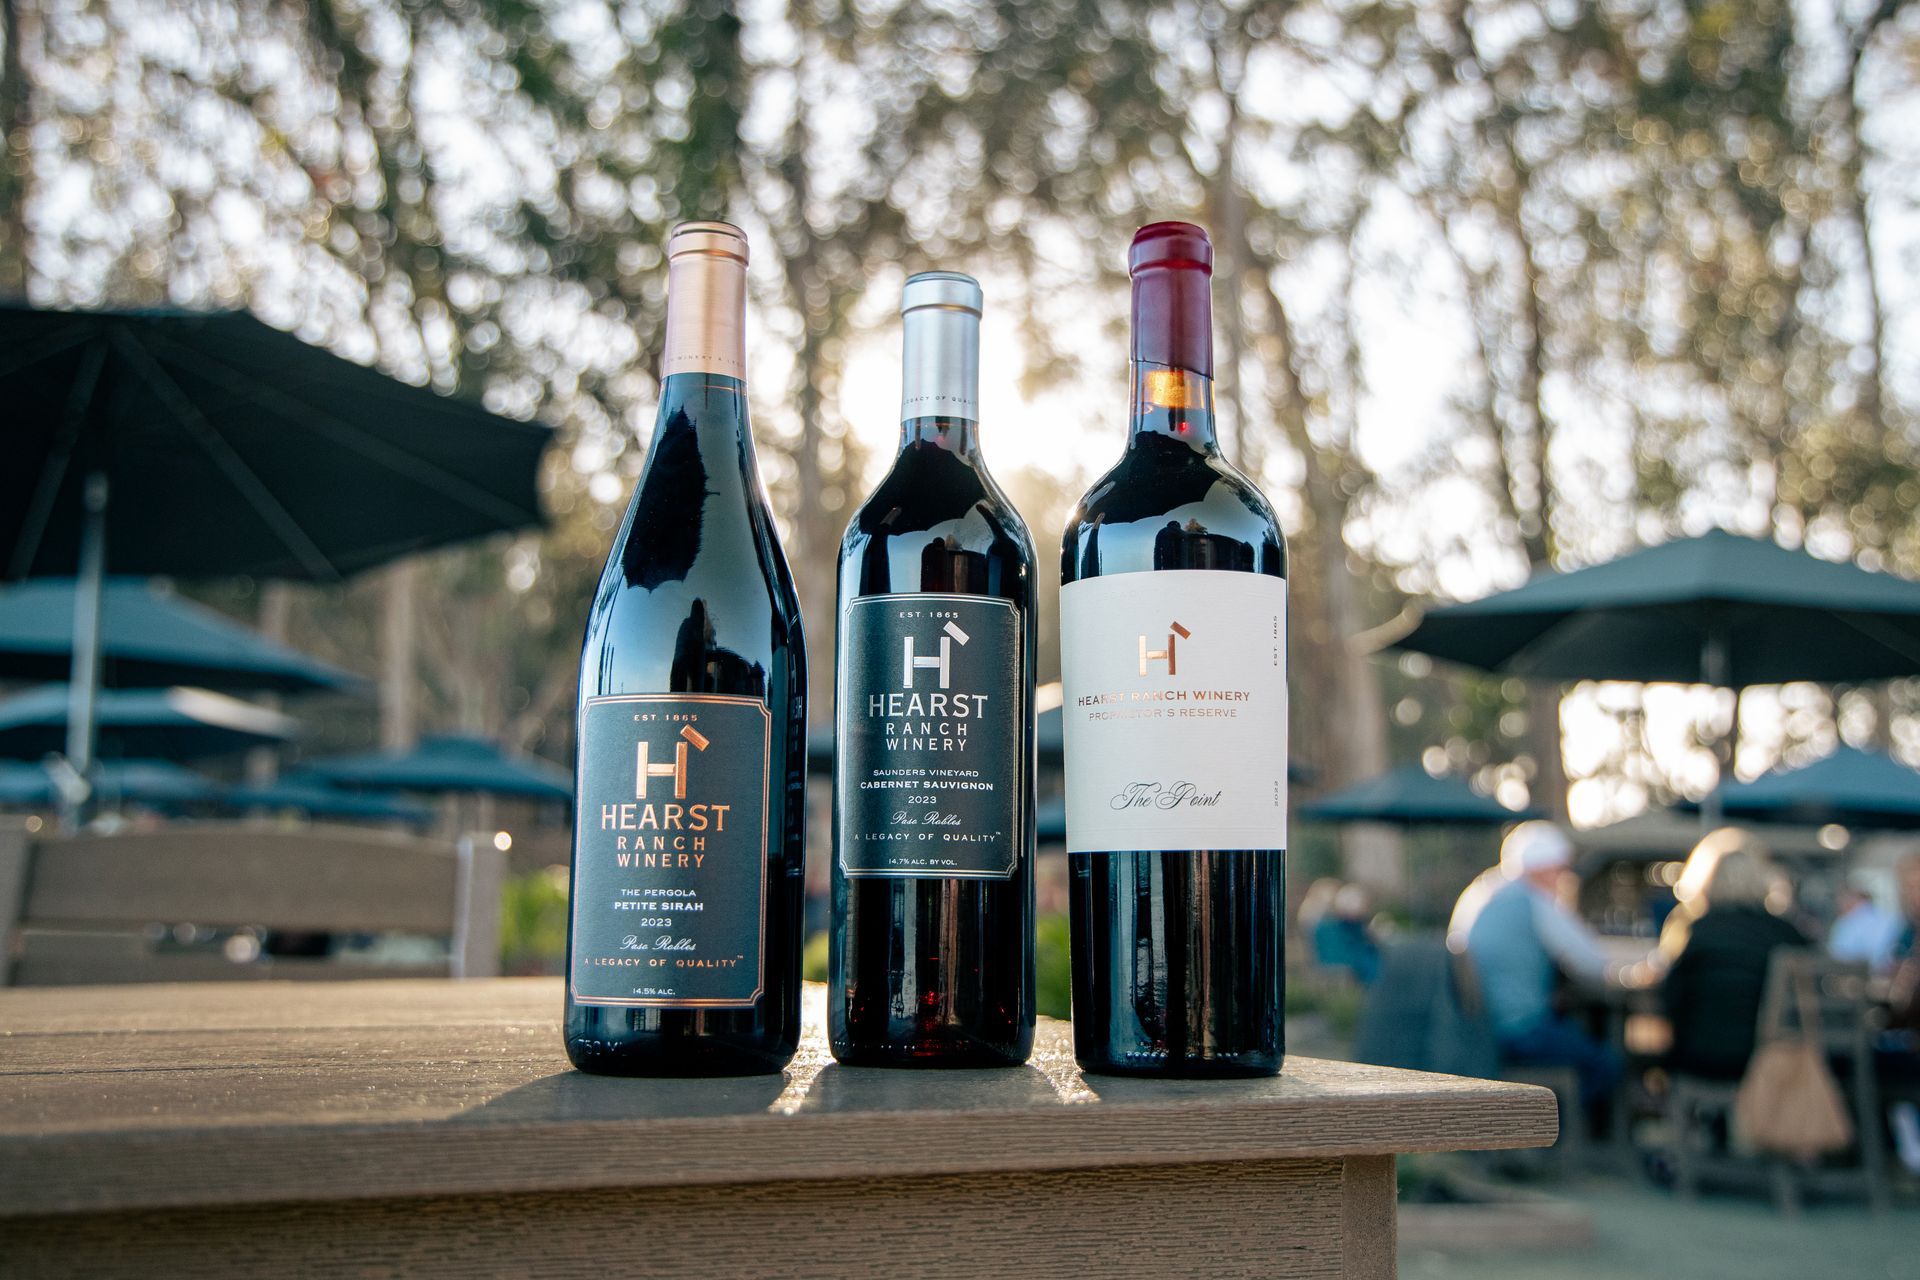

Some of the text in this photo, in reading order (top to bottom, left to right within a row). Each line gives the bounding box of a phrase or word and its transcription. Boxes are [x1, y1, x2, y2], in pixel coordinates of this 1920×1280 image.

[929, 611, 959, 619] 1865
[1078, 690, 1251, 707] HEARST RANCH WINERY
[868, 692, 989, 719] HEARST
[665, 714, 699, 722] 1865
[1180, 708, 1238, 719] RESERVE
[886, 722, 968, 736] RANCH
[886, 738, 968, 751] WINERY
[873, 769, 979, 778] SAUNDERS VINEYARD
[860, 781, 994, 791] CABERNET SAUVIGNON
[908, 795, 937, 804] 2023
[1110, 780, 1222, 810] The Point
[601, 803, 731, 832] HEARST
[890, 810, 962, 826] Paso Robles
[854, 833, 859, 841] A
[865, 833, 910, 841] LEGACY
[918, 833, 935, 841] OF
[617, 836, 706, 851] RANCH
[617, 853, 705, 868] WINERY
[888, 858, 909, 866] 14.7%
[911, 858, 928, 866] ALC.
[930, 858, 939, 866] BY
[621, 888, 697, 897] THE PERGOLA
[614, 901, 704, 912] PETITE SIRAH
[640, 917, 672, 927] 2023
[619, 934, 697, 951] Paso Robles
[584, 958, 589, 966] A
[594, 958, 641, 967] LEGACY
[649, 958, 667, 967] OF
[632, 987, 676, 996] 14.5% ALC.
